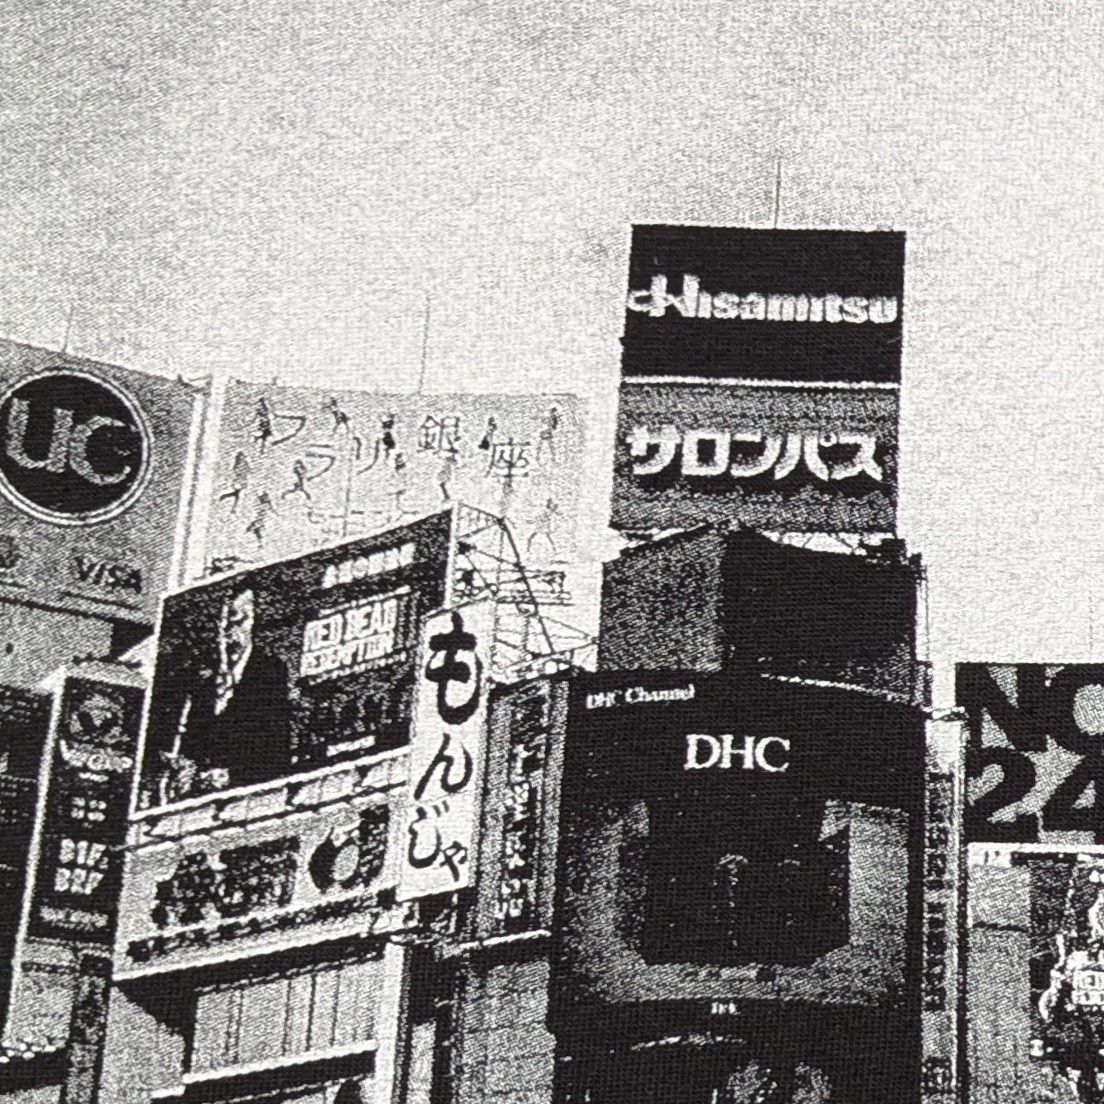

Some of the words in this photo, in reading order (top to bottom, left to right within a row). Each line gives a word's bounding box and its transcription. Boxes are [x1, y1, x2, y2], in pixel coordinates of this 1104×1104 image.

[628, 273, 898, 323] Hisamitsu
[625, 424, 883, 481] サロンパス
[408, 611, 482, 883] もんじゃ
[683, 733, 791, 772] DHC
